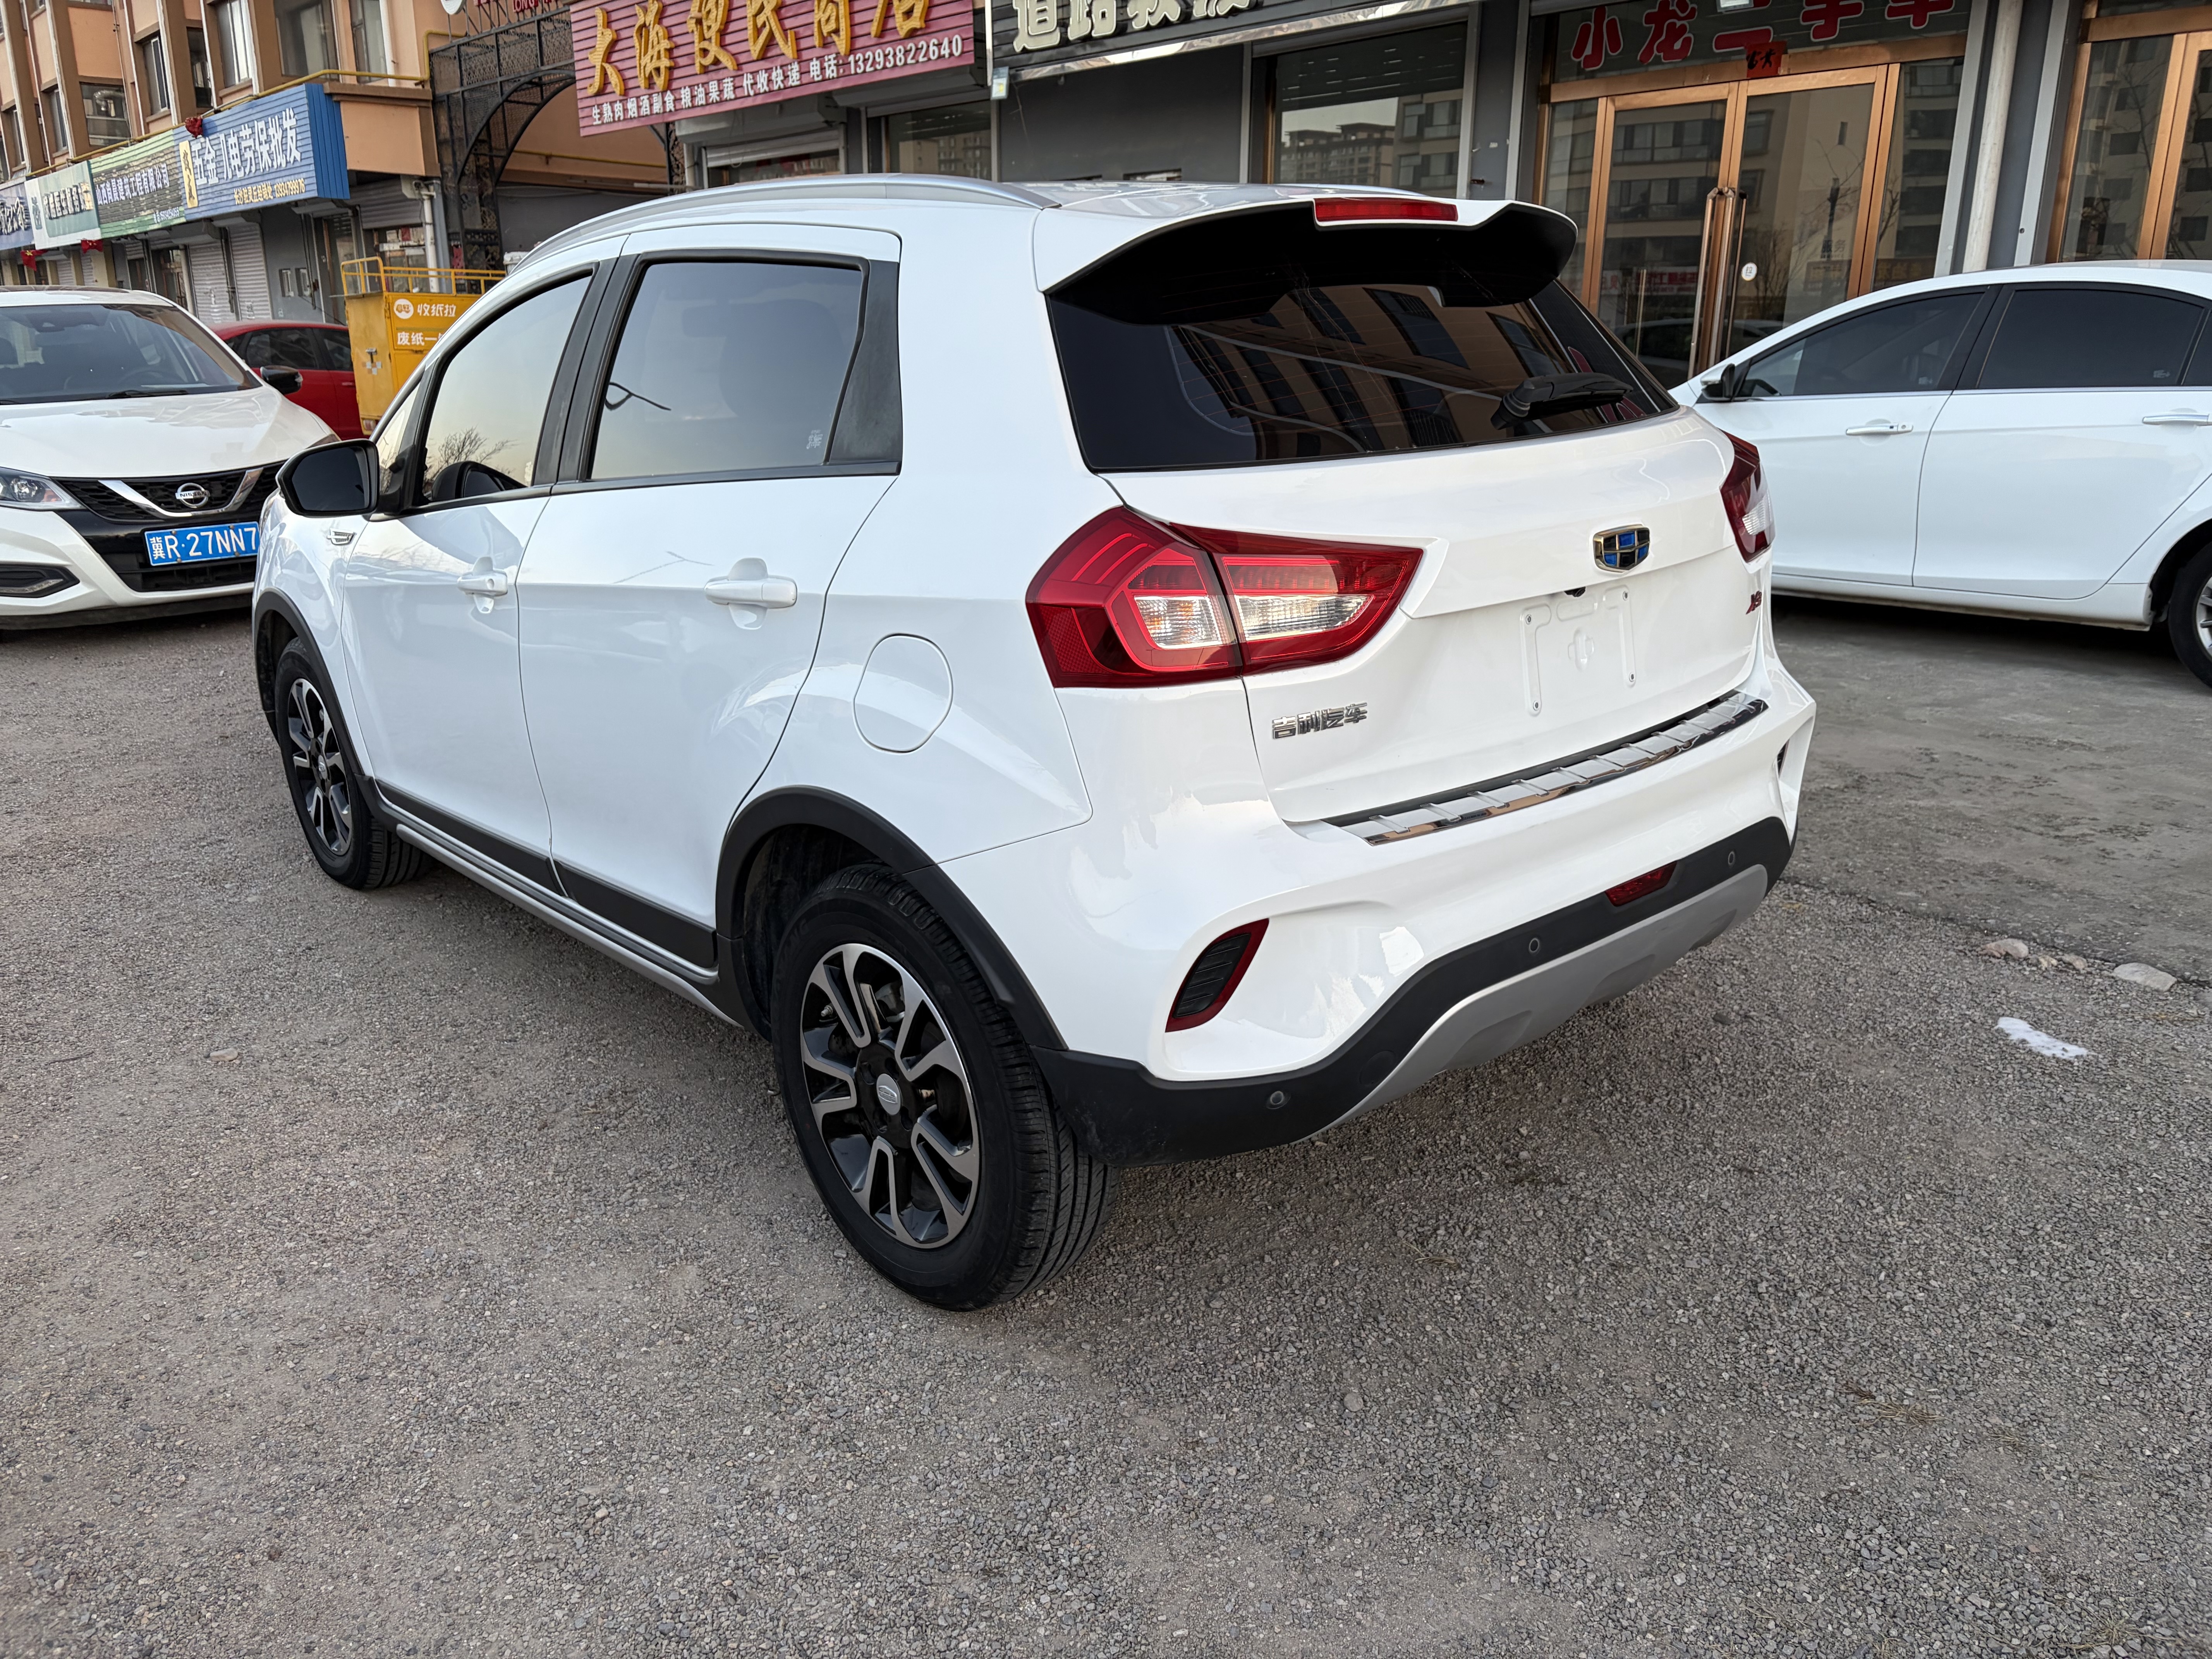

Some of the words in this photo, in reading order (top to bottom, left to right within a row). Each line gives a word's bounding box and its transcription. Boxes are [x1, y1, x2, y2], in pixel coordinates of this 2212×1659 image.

[1013, 0, 1250, 53] 道路
[1272, 702, 1368, 739] 吉利汽车
